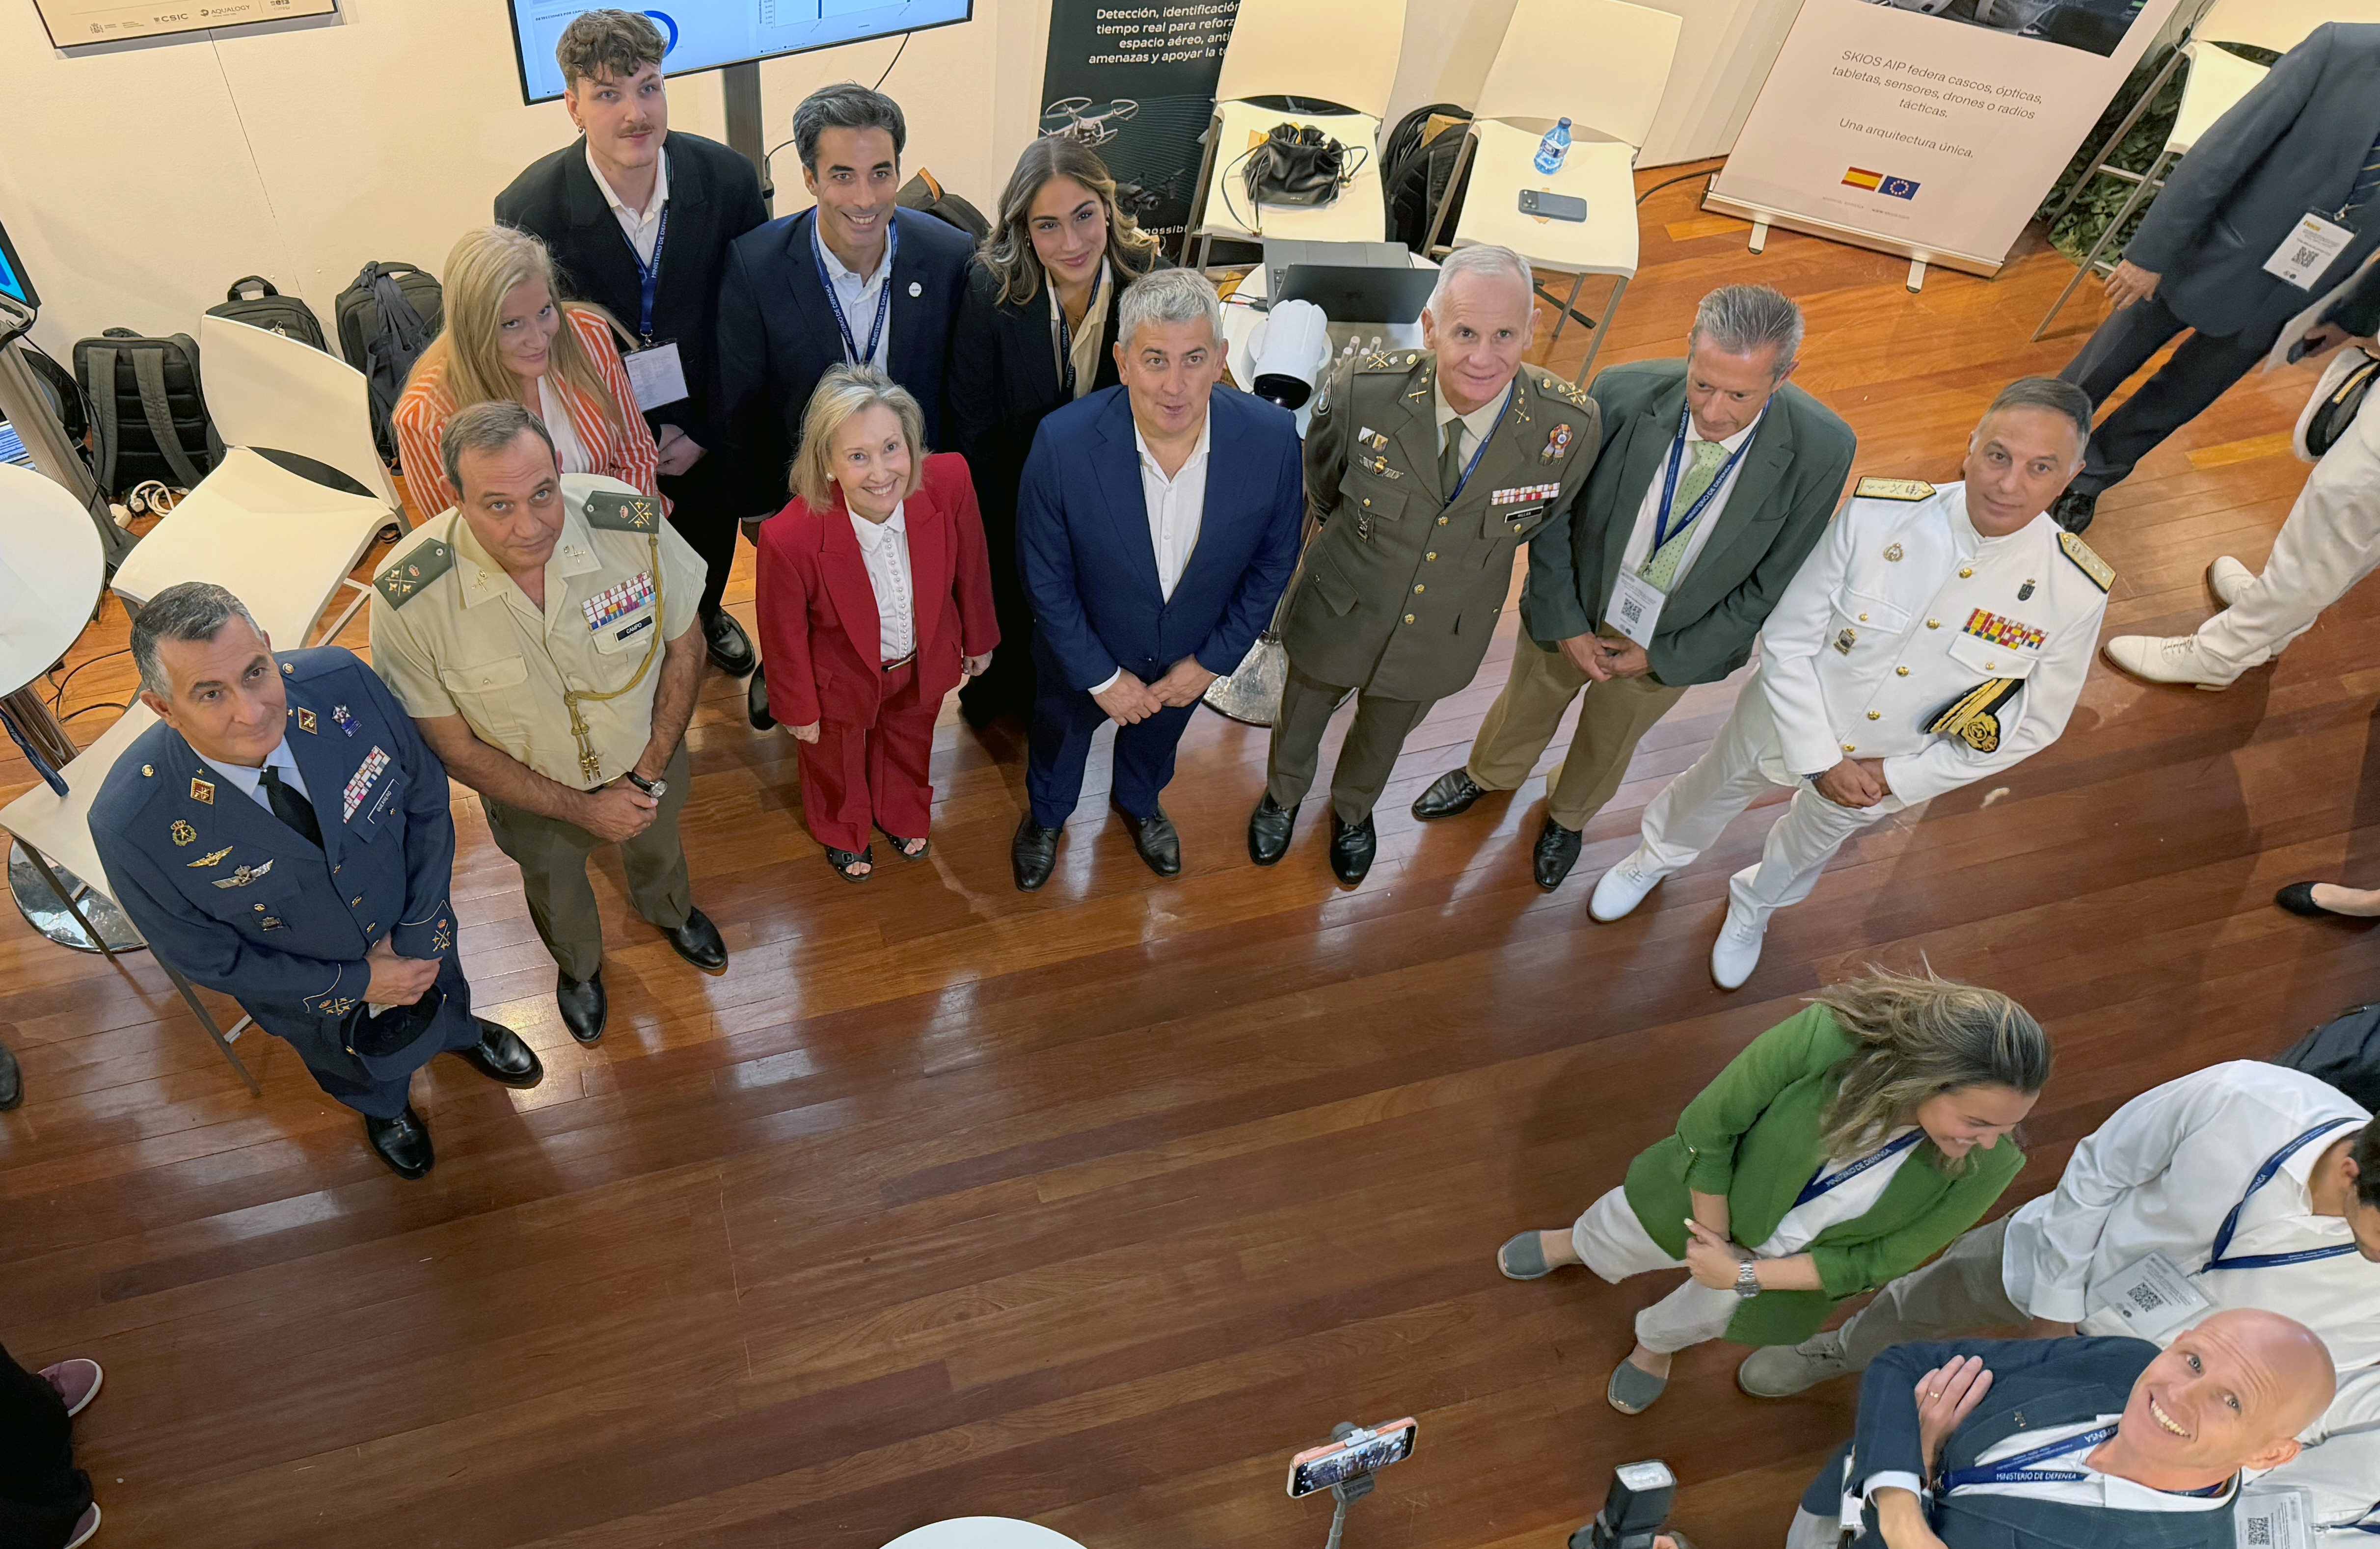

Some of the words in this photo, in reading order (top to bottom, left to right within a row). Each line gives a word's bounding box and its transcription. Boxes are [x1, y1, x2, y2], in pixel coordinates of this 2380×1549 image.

[161, 13, 189, 22] CSIC
[211, 5, 250, 14] AQUALOGY
[1096, 8, 1159, 20] Detección,
[1097, 24, 1139, 36] tiempo
[1143, 22, 1166, 33] real
[1169, 22, 1196, 34] para
[1119, 37, 1164, 50] espacio
[1167, 35, 1204, 47] aéreo,
[1089, 53, 1149, 64] amenazas
[1151, 53, 1160, 64] y
[1162, 49, 1203, 63] apoyar
[1205, 47, 1216, 57] la
[1842, 50, 1882, 67] SKIOS
[1883, 59, 1907, 71] AIP
[1907, 64, 1946, 82] federa
[1948, 75, 1993, 94] cascos,
[1996, 85, 2042, 105] ópticas,
[1832, 66, 1881, 86] tabletas,
[1884, 79, 1940, 99] sensores,
[1943, 91, 1984, 109] drones
[1998, 105, 2036, 120] radios
[1899, 98, 1948, 118] tácticas.
[1839, 118, 1864, 132] Una
[1866, 126, 1937, 149] arquitectura
[1939, 142, 1974, 158] única.
[651, 245, 663, 278] MINISTERIO
[1715, 464, 1732, 488] DEFENSA
[626, 622, 642, 634] CAMPO
[1996, 1472, 2033, 1481] MINISTERIO
